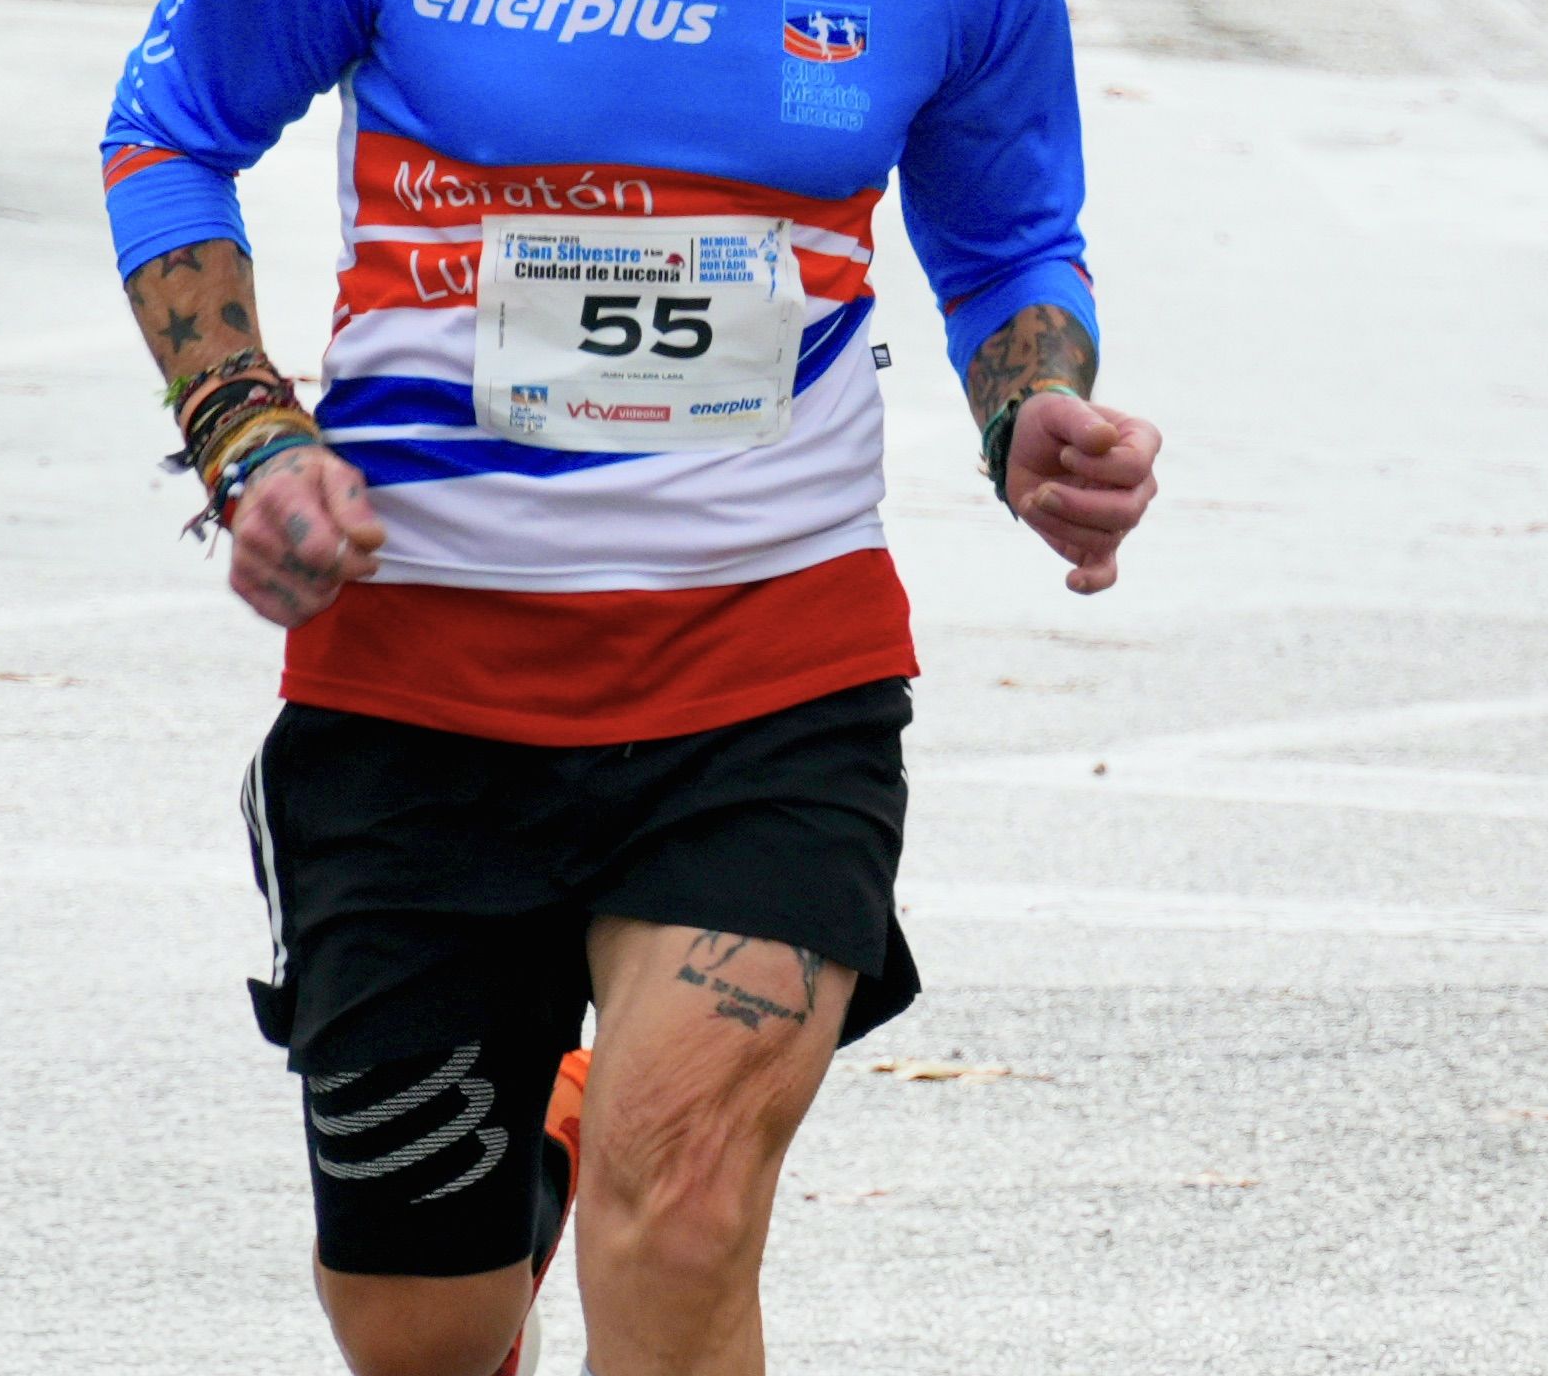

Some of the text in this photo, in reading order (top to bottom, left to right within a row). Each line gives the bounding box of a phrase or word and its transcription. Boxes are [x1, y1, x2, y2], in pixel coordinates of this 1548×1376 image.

[783, 60, 835, 85] Club
[781, 101, 865, 132] Lucena
[394, 159, 654, 216] Maratón
[518, 241, 552, 261] San
[557, 243, 642, 264] Silvestre
[700, 236, 748, 247] MEMORIAL
[725, 249, 758, 259] CARLOS
[514, 261, 681, 283] Ciudad de Lucena
[578, 295, 713, 359] 55
[566, 398, 613, 422] vtv
[689, 397, 764, 417] enerplus
